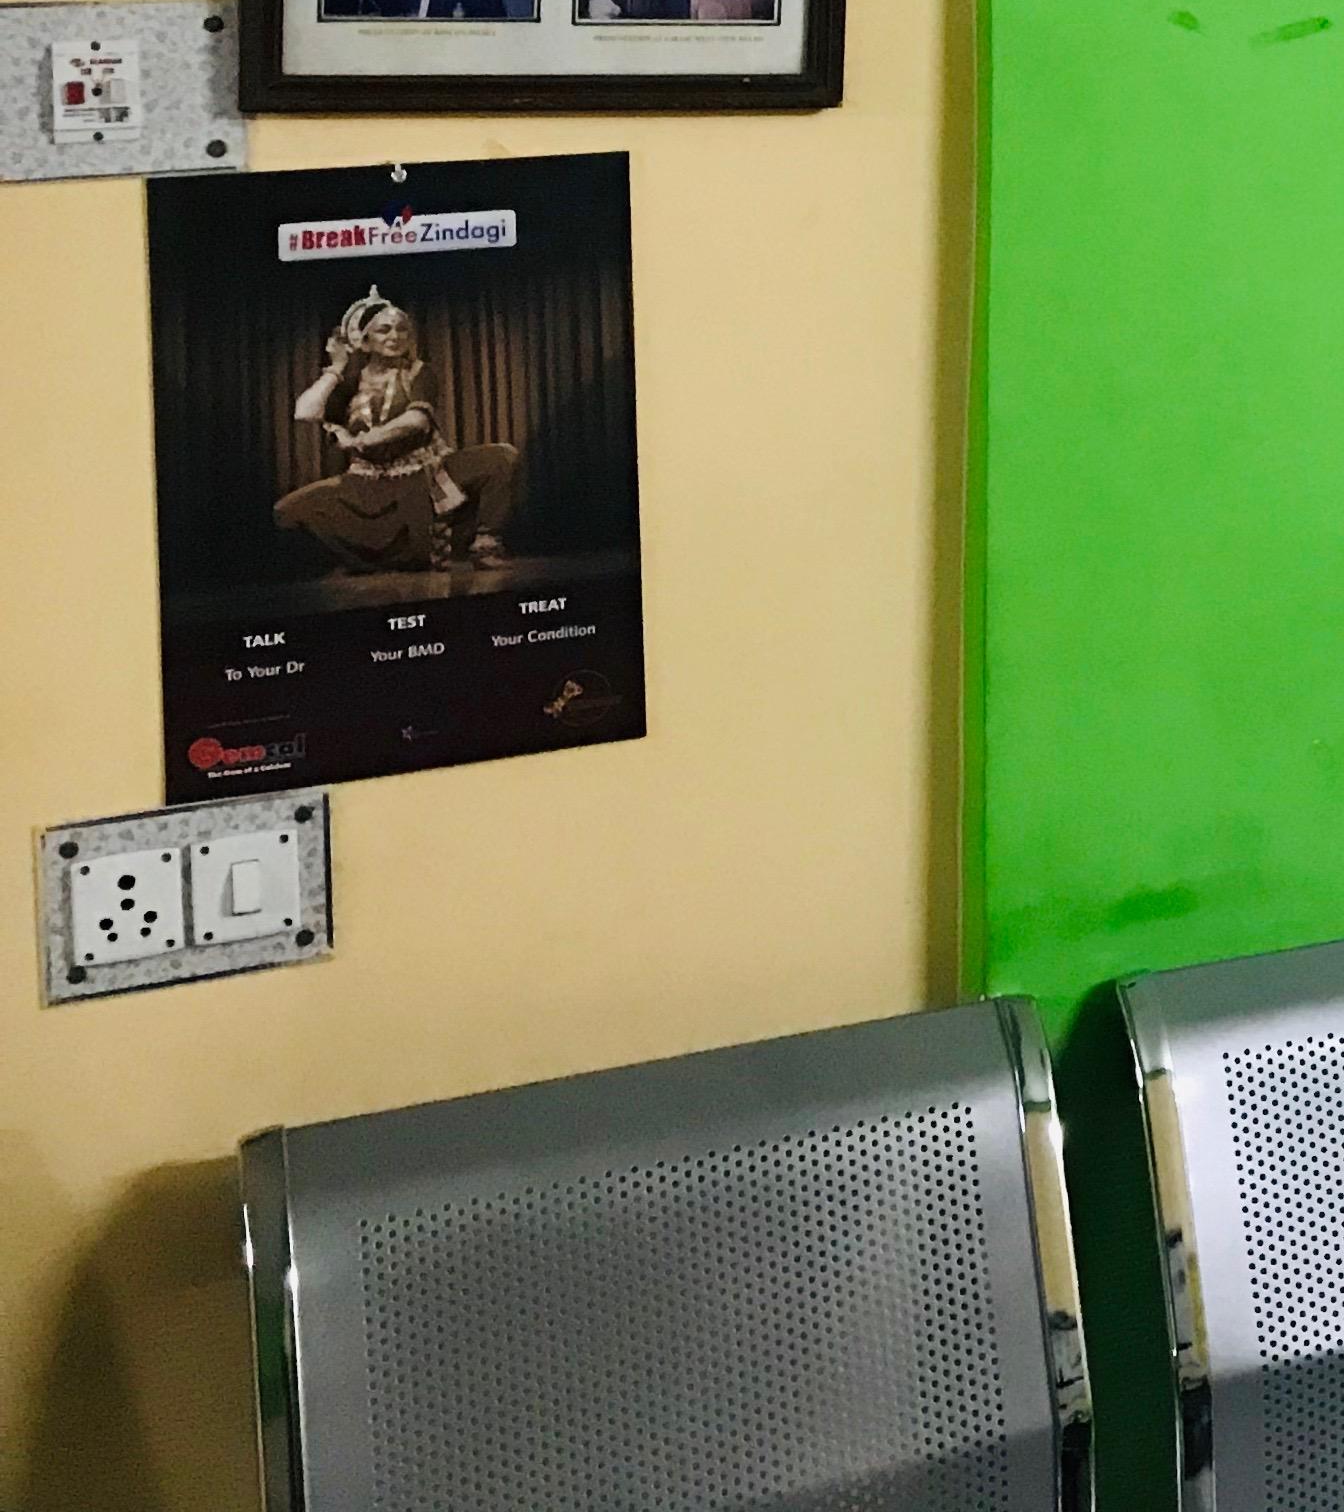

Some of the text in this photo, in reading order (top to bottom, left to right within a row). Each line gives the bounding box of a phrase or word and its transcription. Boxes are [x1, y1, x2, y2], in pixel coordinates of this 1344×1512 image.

[518, 597, 568, 615] TREAT
[387, 614, 427, 630] TEST
[243, 631, 286, 649] TALK
[491, 623, 597, 648] Your Condition
[370, 641, 446, 663] Your BMD
[225, 660, 305, 682] To Your Dr
